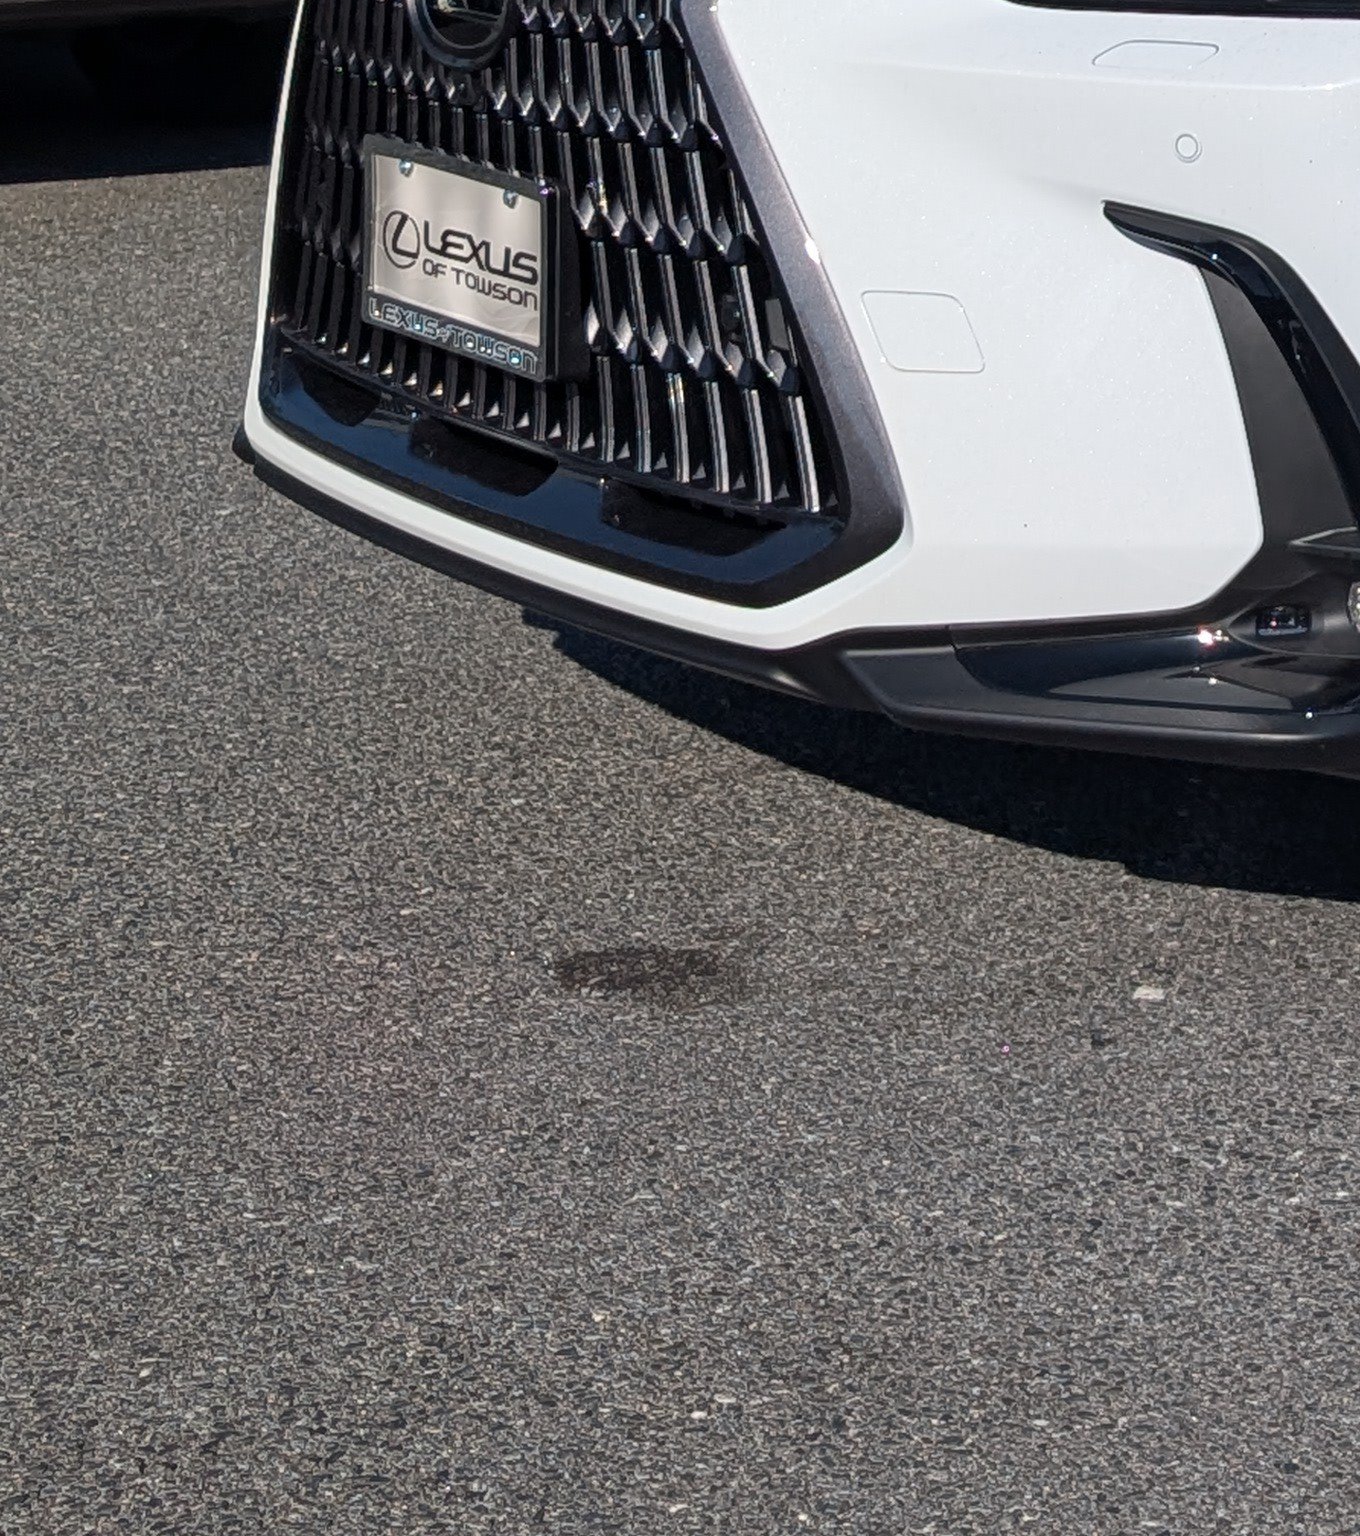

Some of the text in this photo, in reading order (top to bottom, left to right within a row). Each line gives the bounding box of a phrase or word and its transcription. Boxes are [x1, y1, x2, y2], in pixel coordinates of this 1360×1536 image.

[422, 259, 538, 311] OF TOWSON
[423, 220, 539, 286] LEXUS
[370, 298, 438, 338] LEXUS
[448, 325, 538, 375] TOWSON
